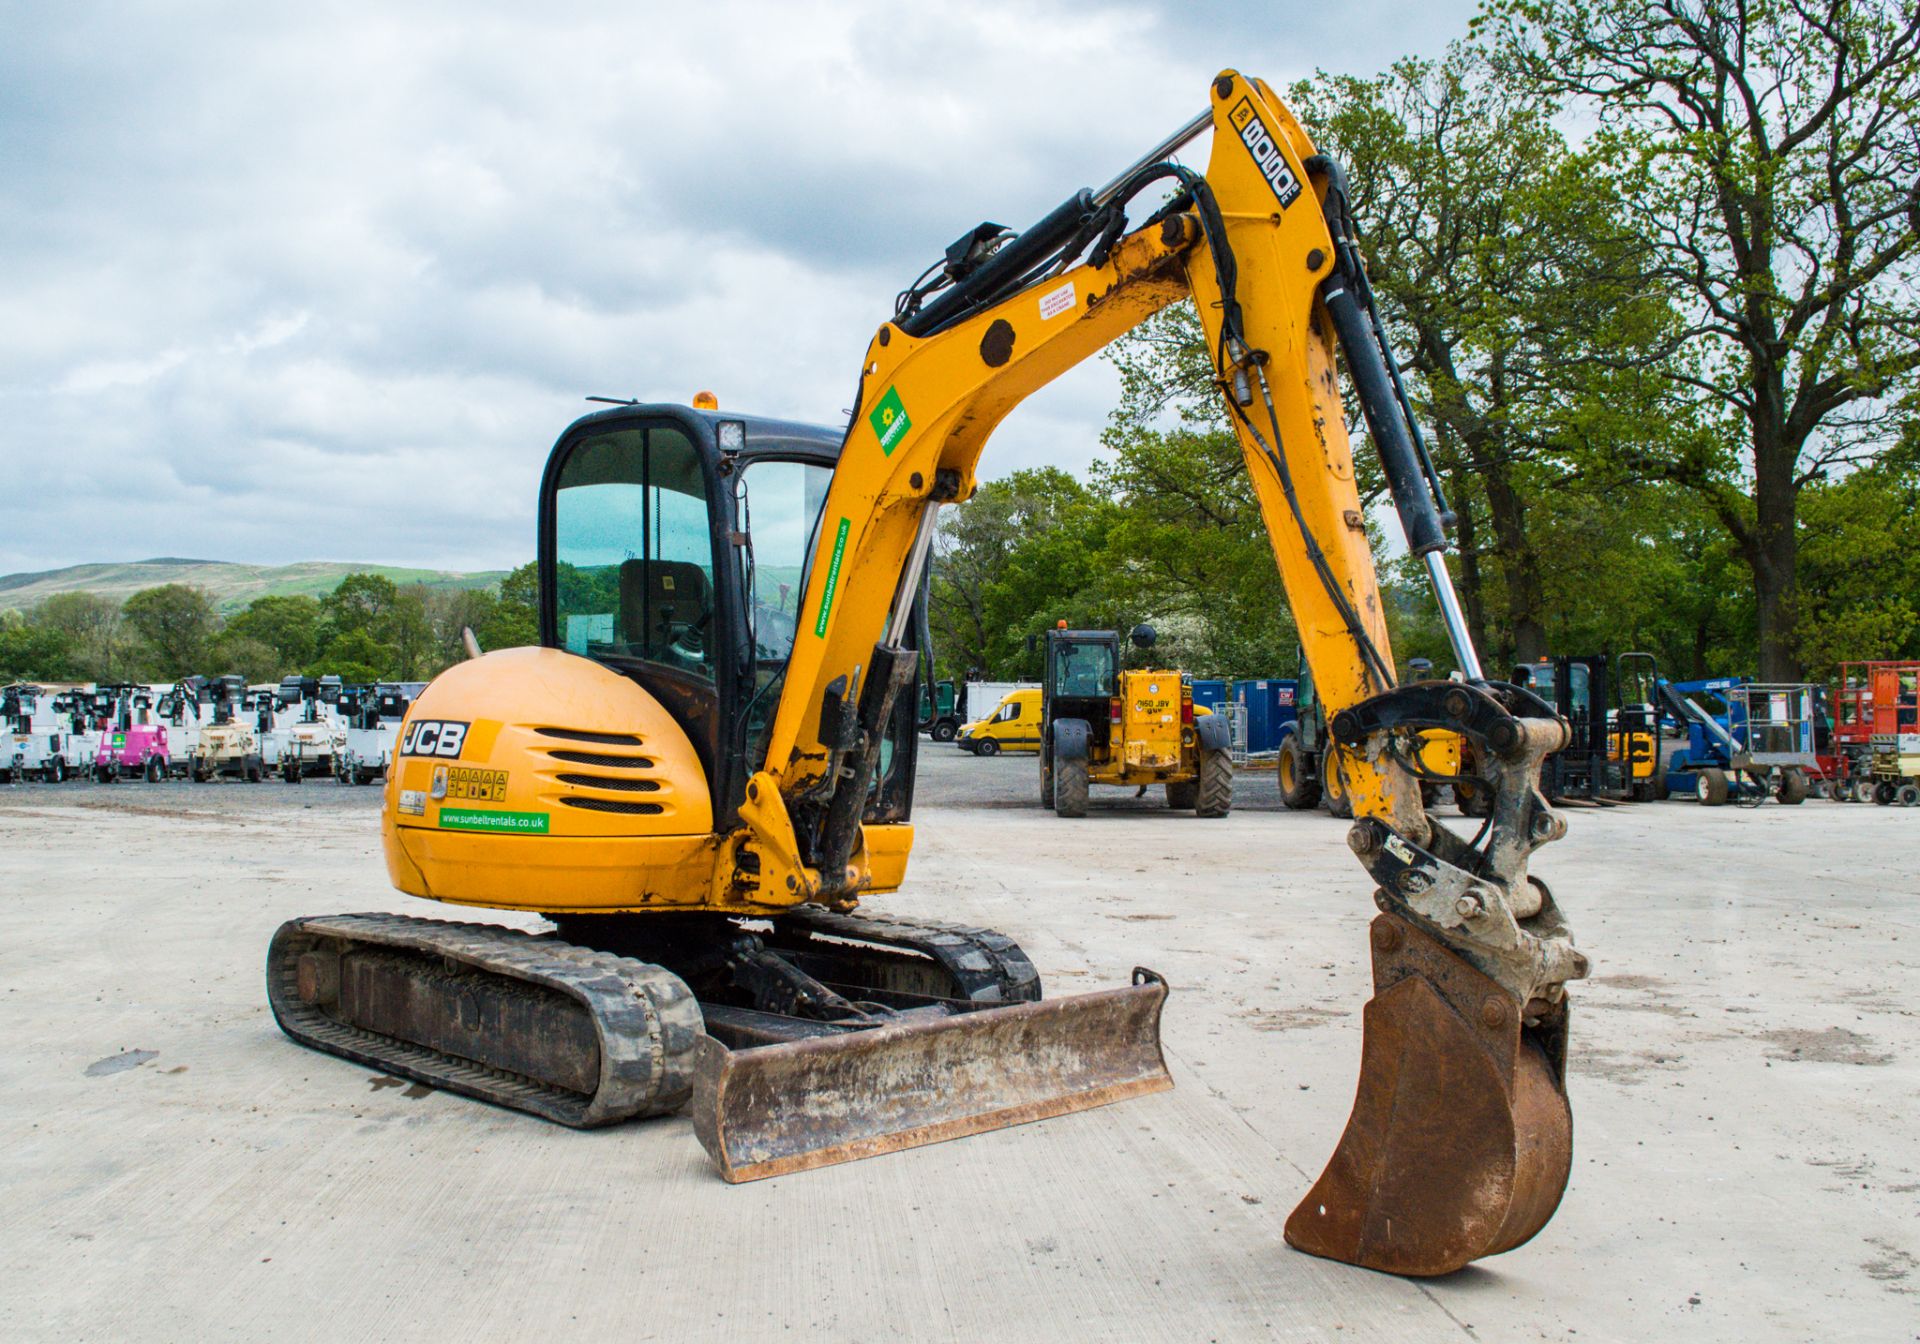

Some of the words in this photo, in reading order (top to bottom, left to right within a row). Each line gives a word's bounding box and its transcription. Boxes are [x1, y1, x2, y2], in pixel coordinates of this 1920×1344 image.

[1242, 118, 1294, 196] 8050
[818, 524, 847, 633] www.sunbeltrentals.co.uk
[401, 721, 467, 757] JCB
[442, 813, 545, 829] www.sunbeltrentals.co.uk
